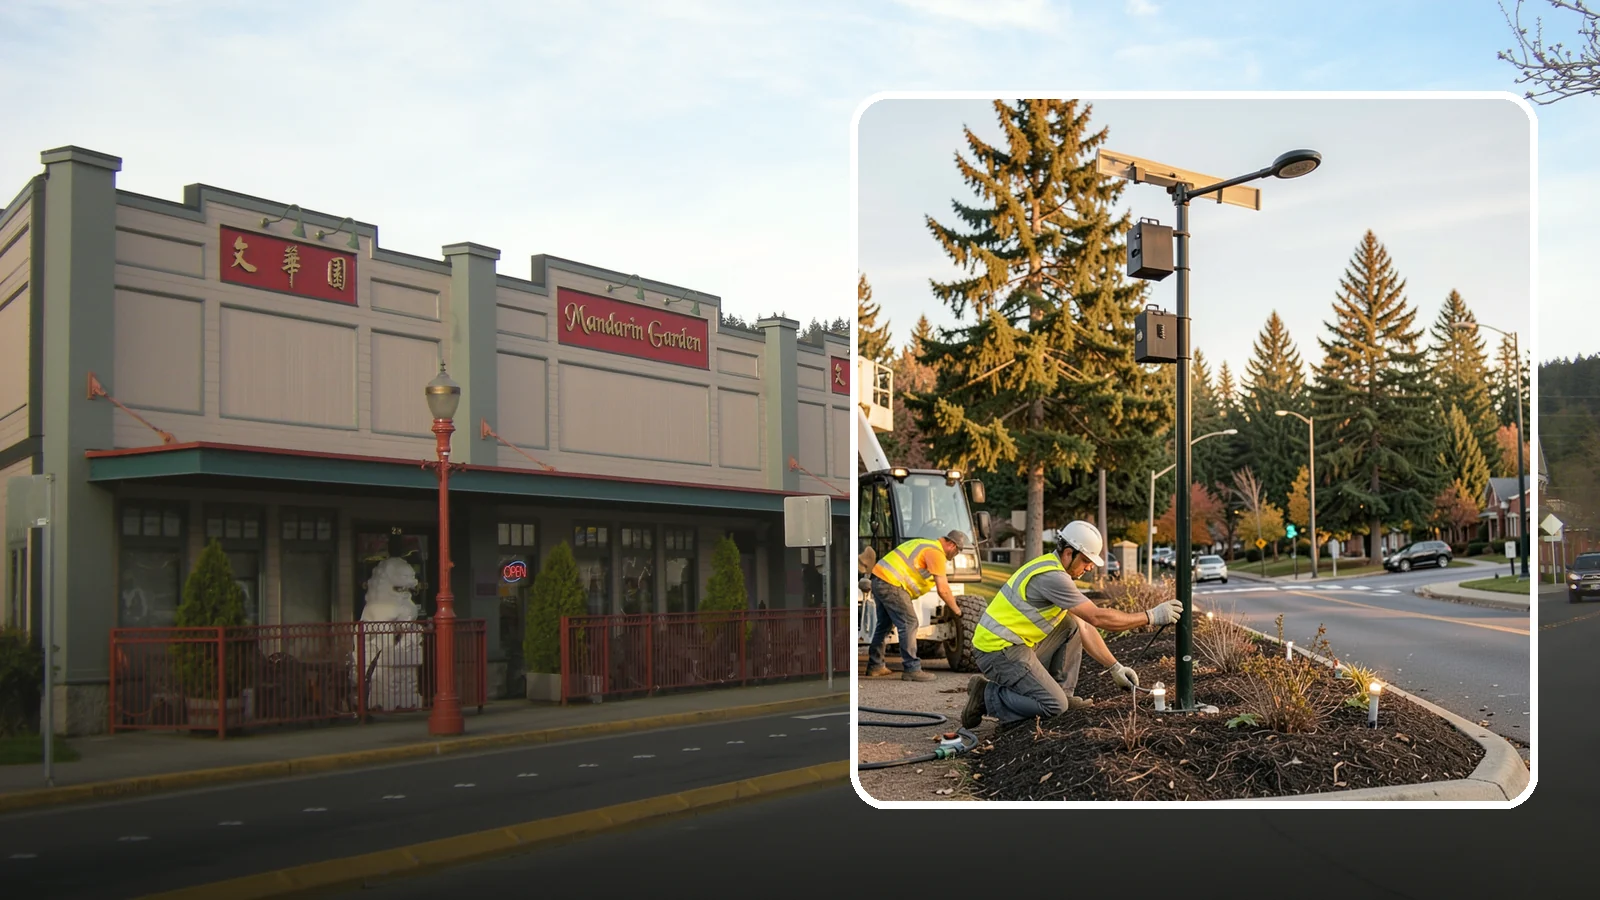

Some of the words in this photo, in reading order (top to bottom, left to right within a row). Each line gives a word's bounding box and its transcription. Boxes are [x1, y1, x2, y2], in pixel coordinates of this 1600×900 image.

[231, 236, 346, 291] 文華園
[564, 302, 644, 341] Mandarin
[647, 320, 702, 352] Garden
[503, 565, 527, 578] OPEN
